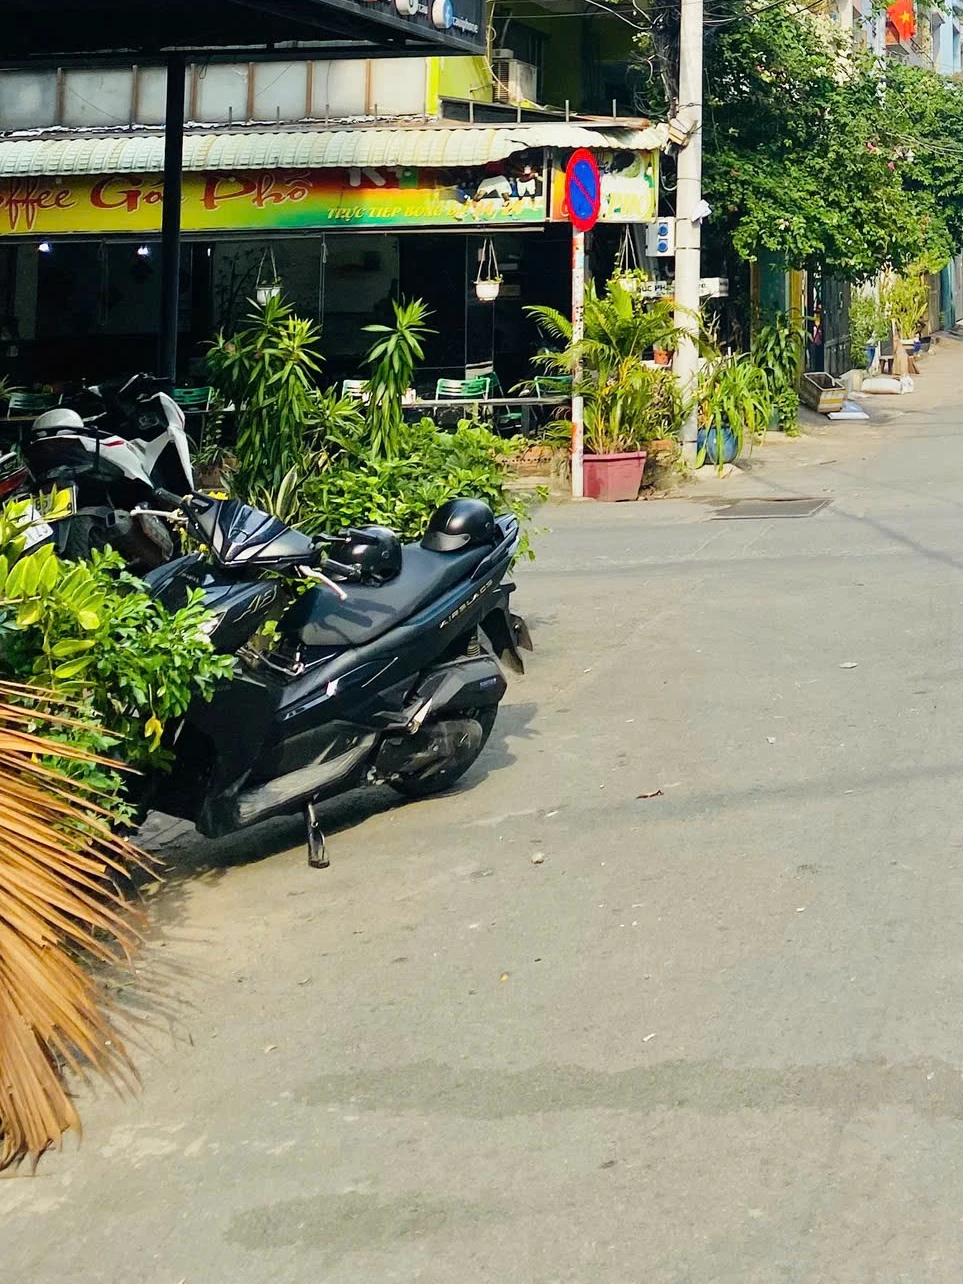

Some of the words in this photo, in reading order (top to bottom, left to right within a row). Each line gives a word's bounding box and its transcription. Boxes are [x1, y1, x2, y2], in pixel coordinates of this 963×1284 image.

[0, 176, 78, 231] ffee
[90, 176, 185, 212] Gó
[200, 170, 313, 210] Phố
